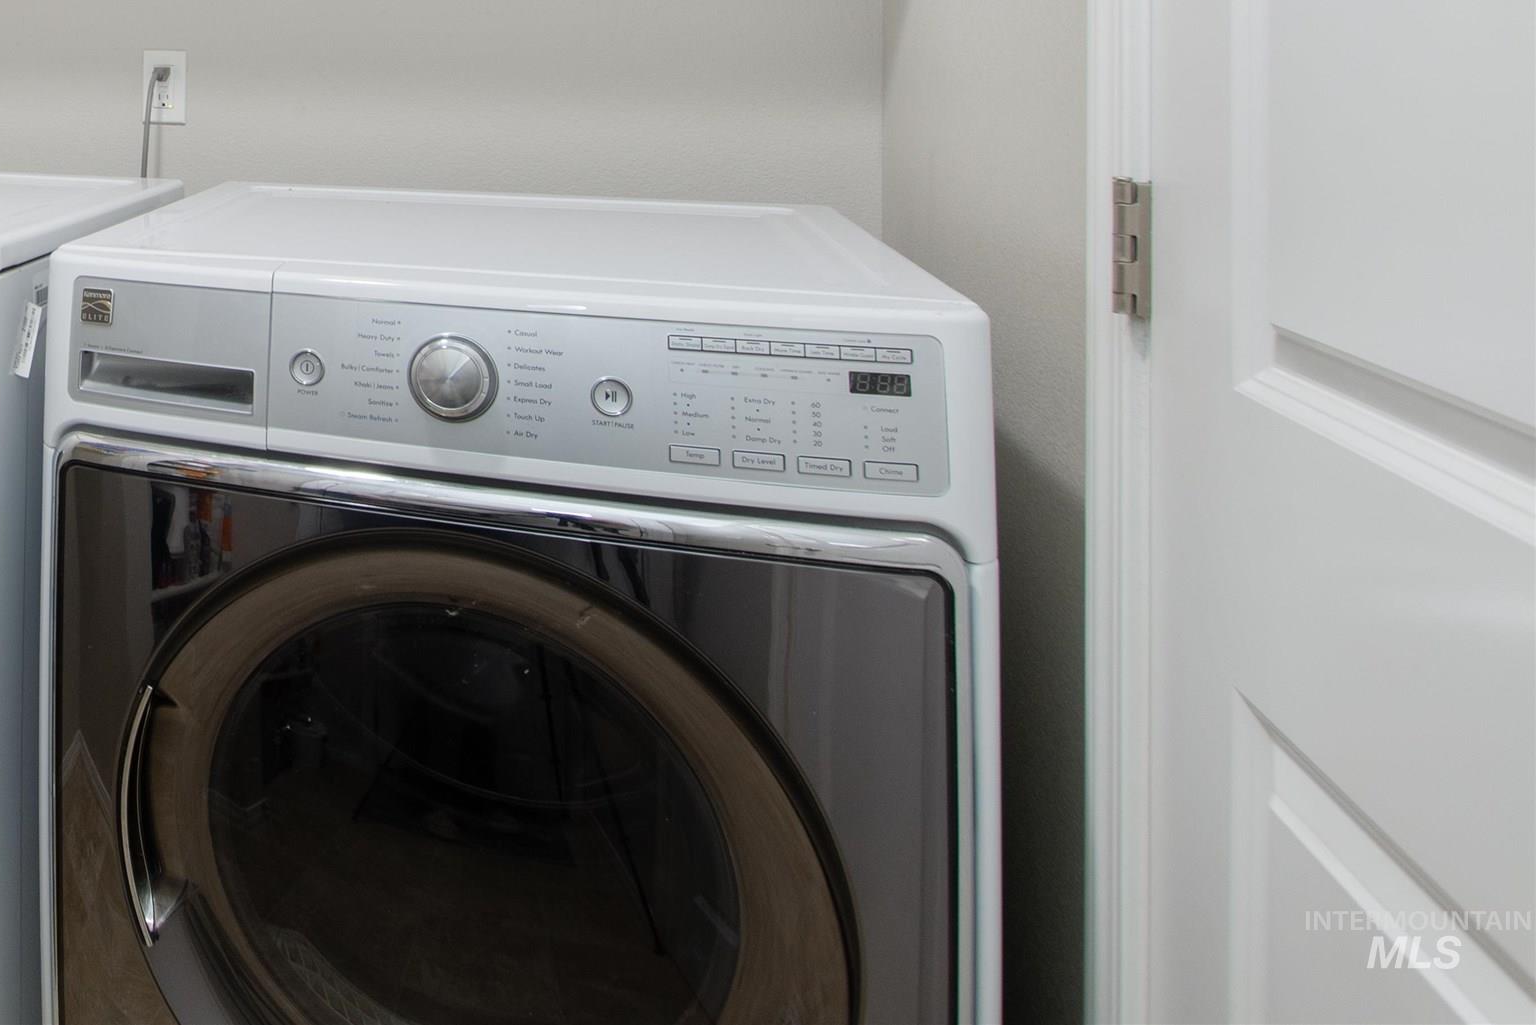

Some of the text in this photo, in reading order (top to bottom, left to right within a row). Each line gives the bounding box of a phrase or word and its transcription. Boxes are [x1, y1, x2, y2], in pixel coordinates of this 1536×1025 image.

[514, 346, 543, 354] Workout
[514, 362, 546, 372] Delicates
[514, 379, 552, 389] Small Load
[514, 396, 552, 406] Express Dry
[763, 398, 776, 406] Dry
[870, 405, 900, 414] Connect
[534, 414, 546, 423] Up
[526, 430, 539, 440] Dry
[741, 455, 776, 466] Dry Level
[804, 461, 844, 472] Timed Dry
